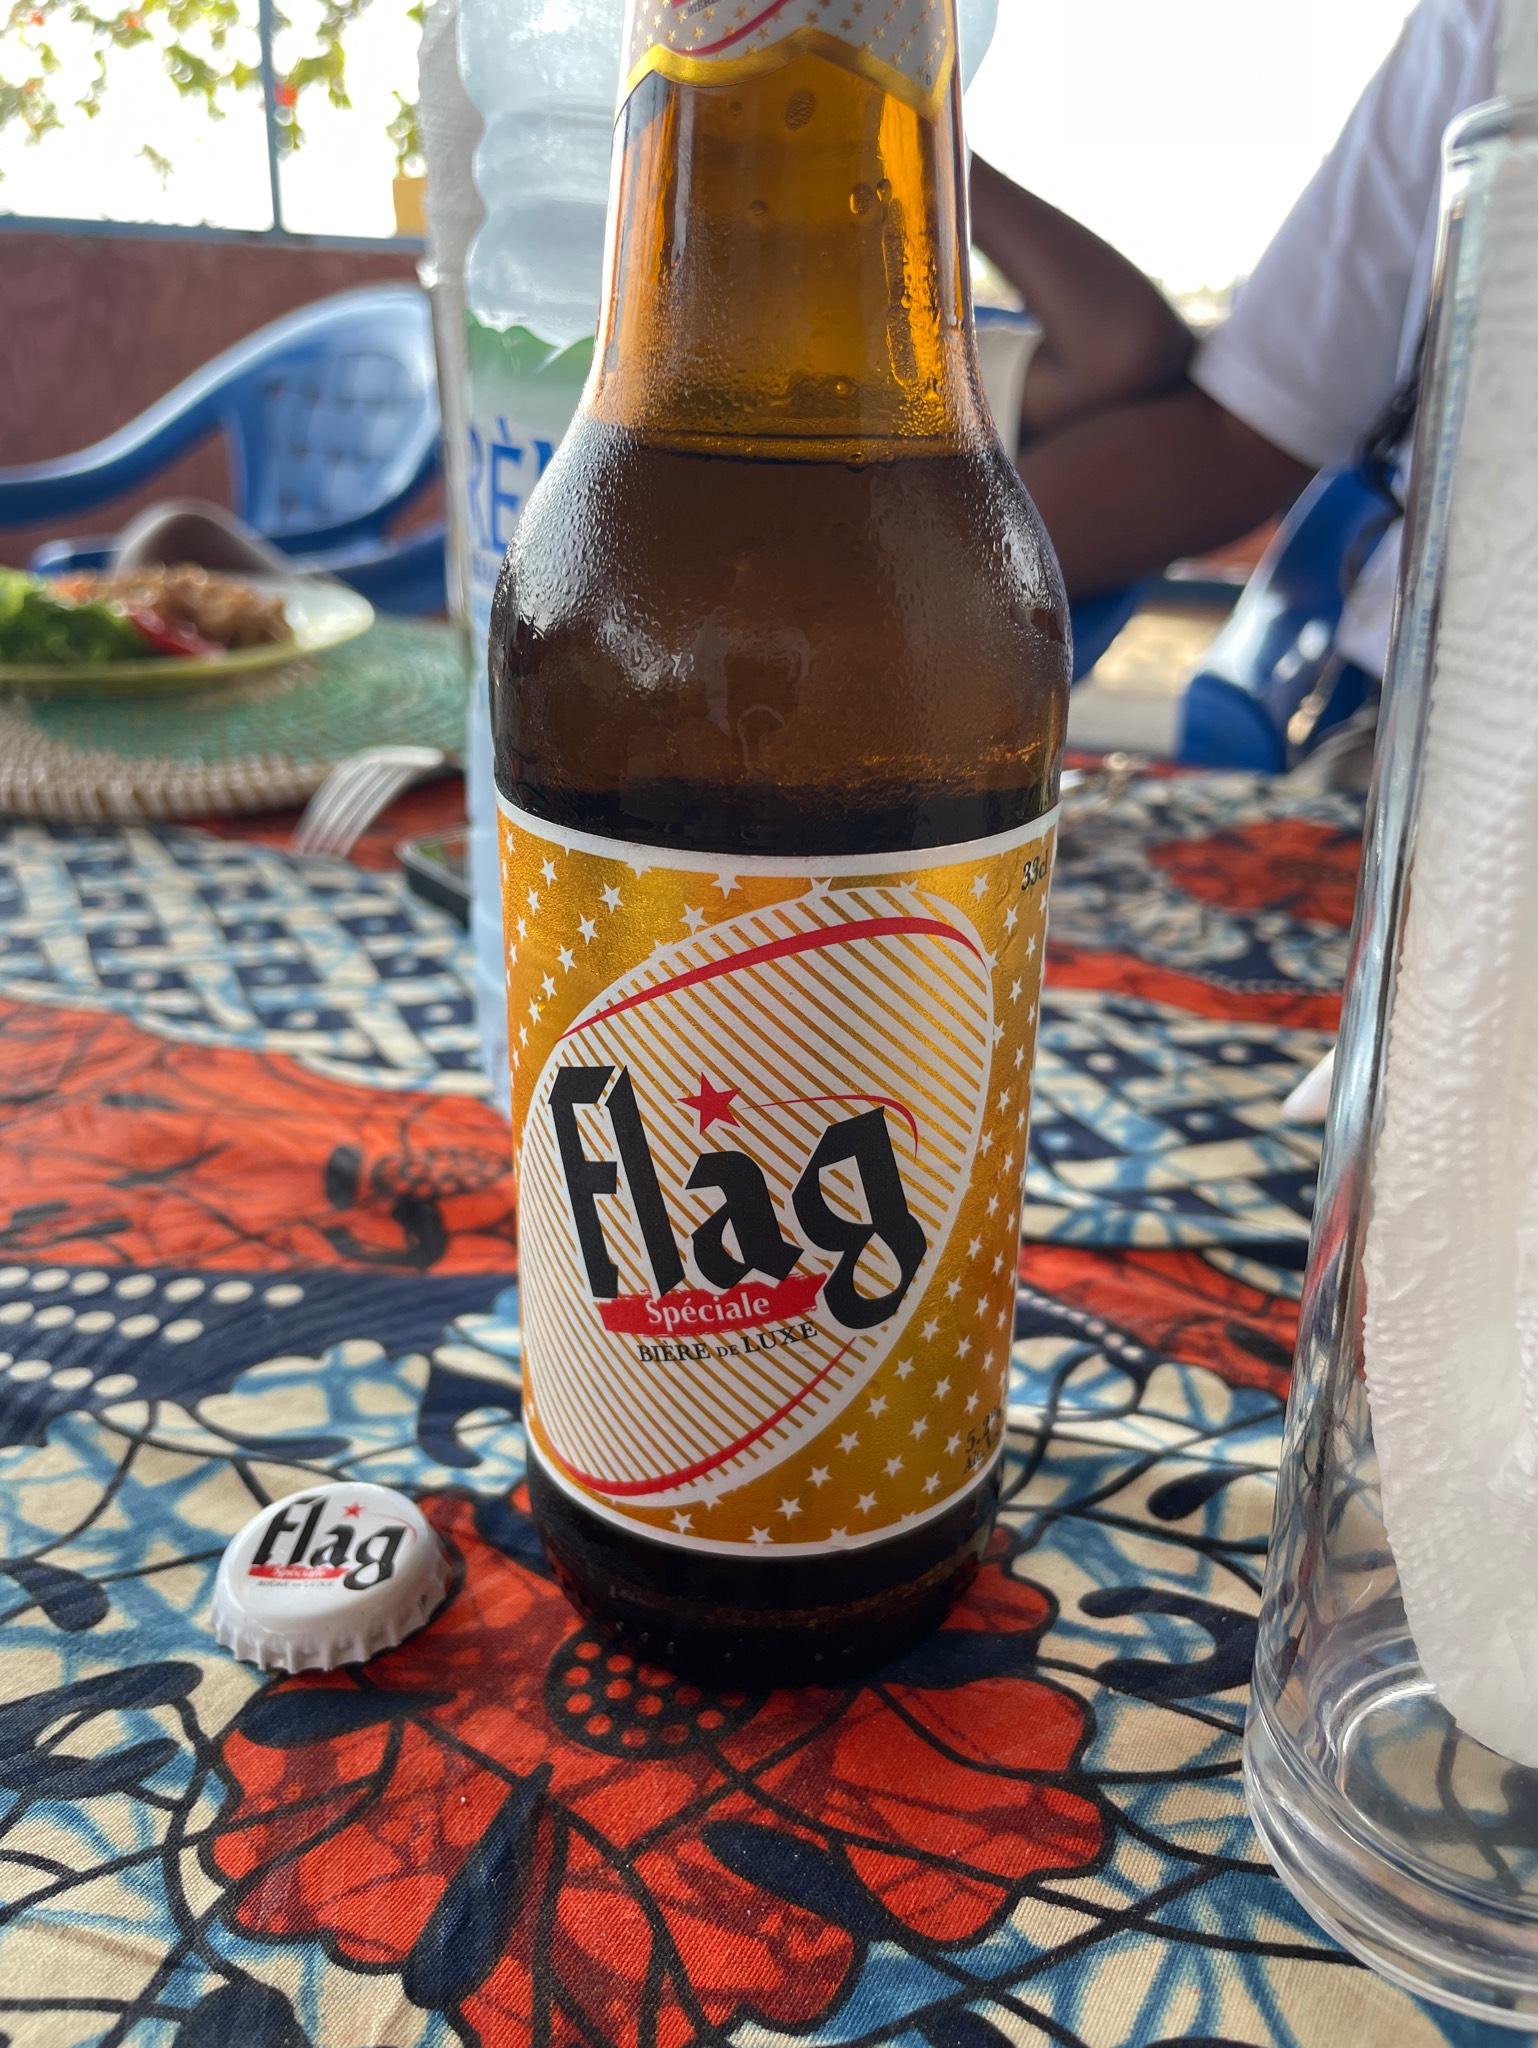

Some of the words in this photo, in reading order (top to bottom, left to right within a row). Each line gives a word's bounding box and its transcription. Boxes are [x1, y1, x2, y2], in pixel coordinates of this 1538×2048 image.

[1021, 847, 1049, 891] 33cl
[548, 1064, 927, 1330] Flag
[645, 1291, 771, 1332] Spéciale
[637, 1340, 711, 1362] BIÈRE
[715, 1344, 740, 1358] DE
[740, 1320, 819, 1354] LUXE
[252, 1495, 408, 1591] Flag
